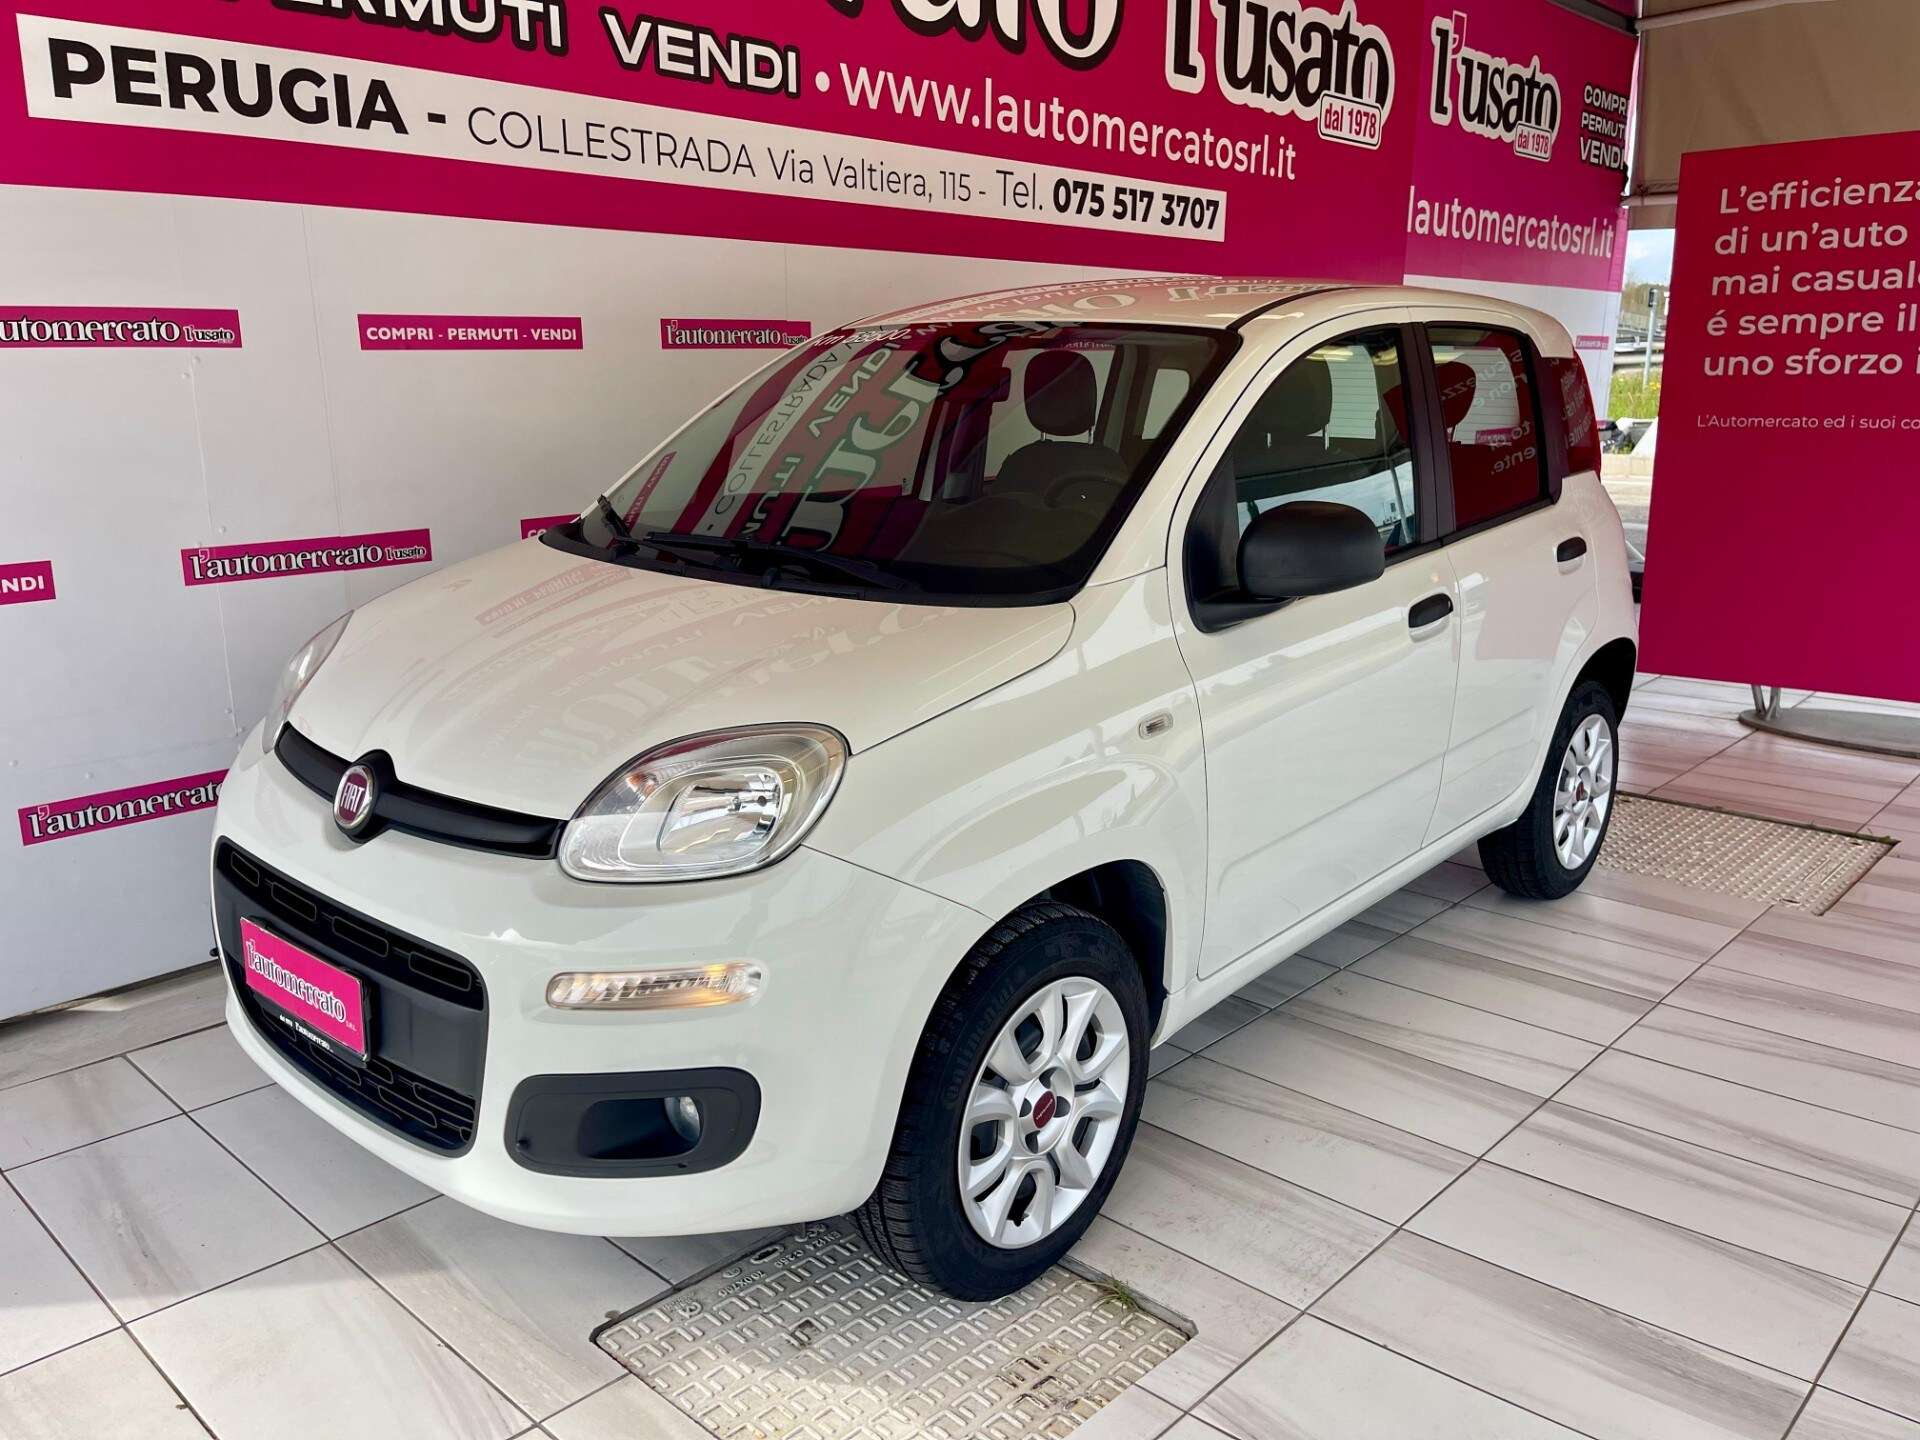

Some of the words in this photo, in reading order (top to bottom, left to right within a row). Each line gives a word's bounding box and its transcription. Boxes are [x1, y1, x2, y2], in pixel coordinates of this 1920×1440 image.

[1172, 0, 1390, 109] lusato
[1433, 10, 1559, 135] l'usato
[603, 12, 799, 95] VENDI
[839, 62, 1296, 181] www.lautomercatosrl.it
[1584, 85, 1629, 115] COMPR
[48, 37, 409, 135] PERUGIA
[467, 107, 756, 178] COLLESTRADA
[767, 147, 814, 185] Via
[823, 155, 933, 203] Valtiera,
[939, 171, 973, 203] 115
[996, 170, 1044, 211] Tel.
[1053, 178, 1104, 218] 075
[1112, 188, 1154, 223] 517
[1160, 192, 1220, 230] 3707
[1324, 103, 1344, 132] dal
[1348, 108, 1377, 139] 1978
[1581, 112, 1626, 138] PERMUT
[1517, 130, 1530, 149] dal
[1531, 133, 1549, 154] 1978
[1580, 136, 1625, 170] VENDI
[1407, 185, 1614, 259] lautomercatosrl.it
[1714, 225, 1749, 255] di
[1761, 222, 1908, 252] un'auto
[1711, 265, 1781, 296] mai
[1791, 260, 1920, 292] casual
[366, 326, 433, 341] COMPRI
[448, 328, 519, 341] PERMUTI
[531, 328, 577, 341] VENDI
[666, 320, 781, 345] l'automercato
[1706, 309, 1728, 336] é
[1737, 310, 1884, 340] sempre
[1897, 303, 1918, 332] il
[1703, 355, 1774, 376] uno
[1785, 347, 1903, 375] sforzo
[1697, 414, 1819, 429] L'Automercato
[1823, 415, 1846, 429] ed
[1850, 415, 1855, 429] i
[1859, 415, 1896, 430] suoi
[0, 575, 45, 594] NDI
[340, 782, 366, 813] FIAT
[246, 939, 347, 1023] l'automercato
